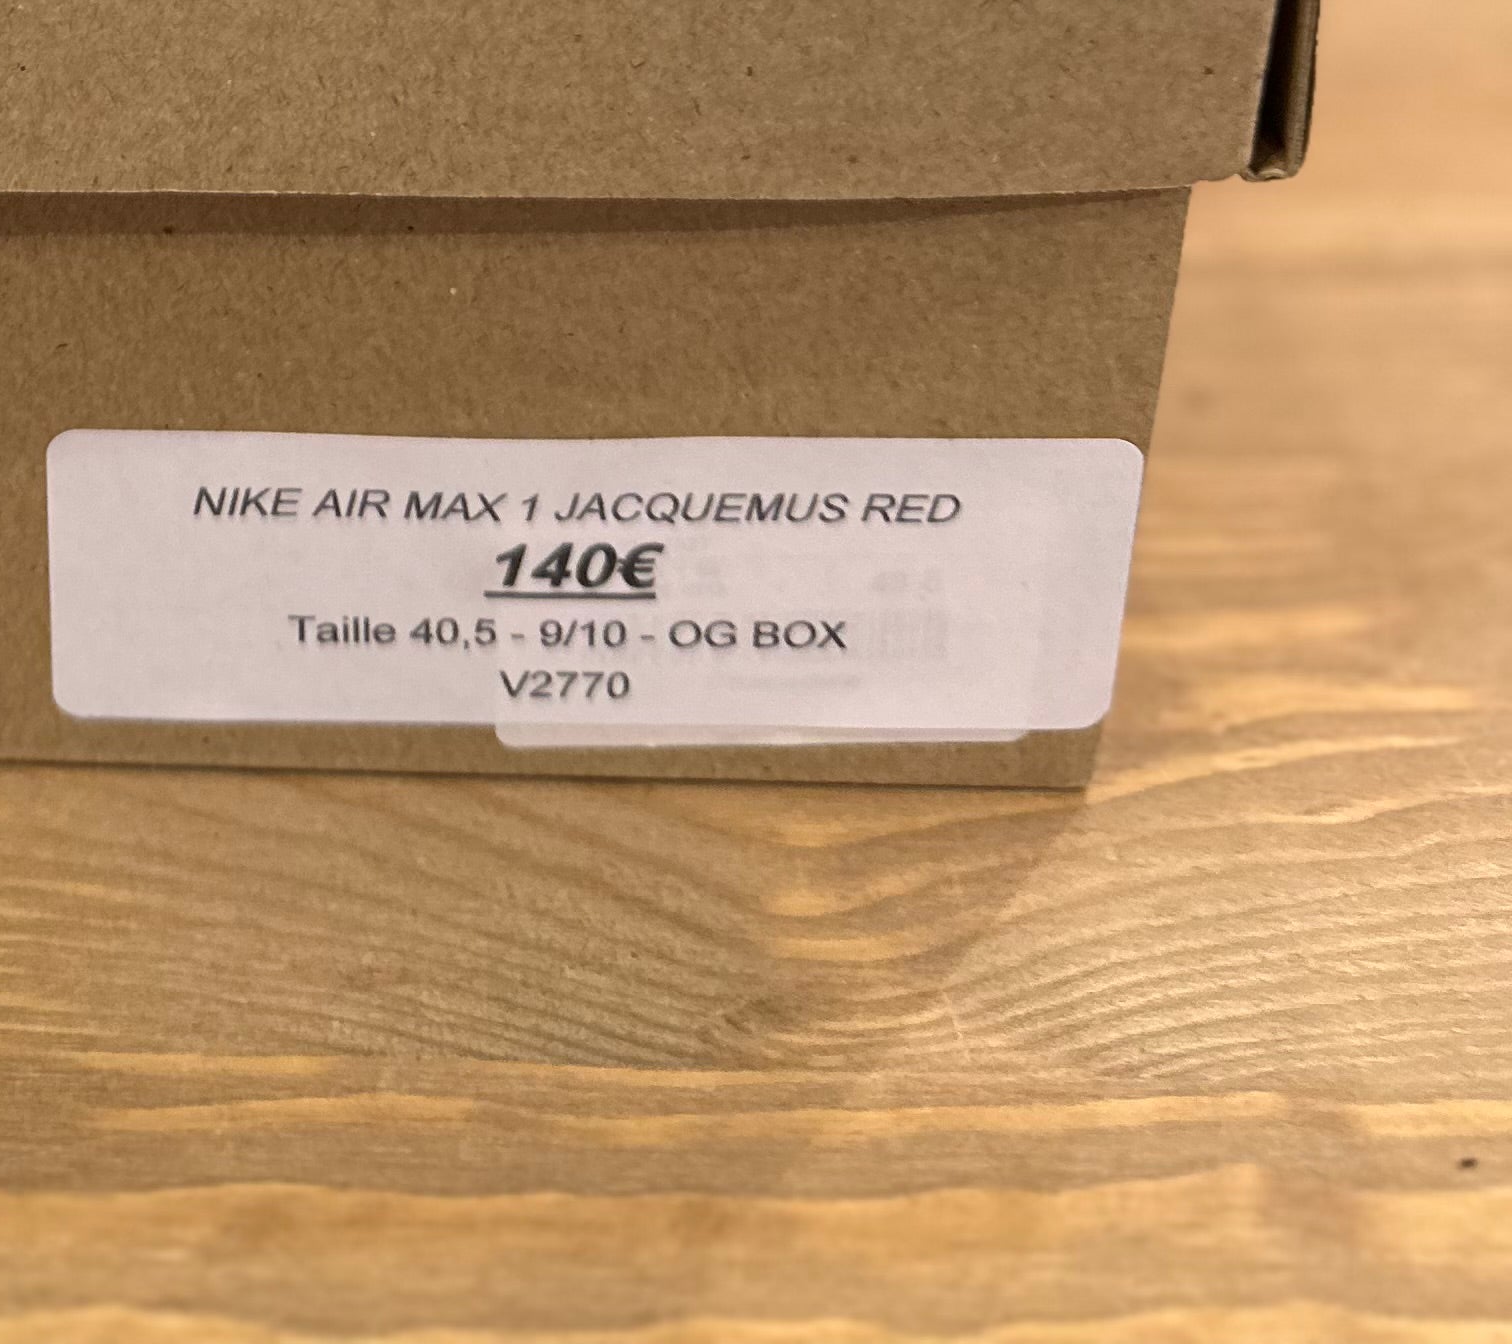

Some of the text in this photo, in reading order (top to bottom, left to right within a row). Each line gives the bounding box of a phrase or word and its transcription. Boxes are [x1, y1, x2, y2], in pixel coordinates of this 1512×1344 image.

[193, 487, 961, 524] NIKE AIR MAX 1 JACQUEMUS RED
[495, 542, 665, 589] 140€
[288, 614, 396, 644] Taille
[409, 617, 497, 649] 40,5
[540, 619, 627, 648] 9/10
[669, 619, 737, 649] OG
[753, 620, 847, 650] BOX
[499, 670, 631, 700] V2770
